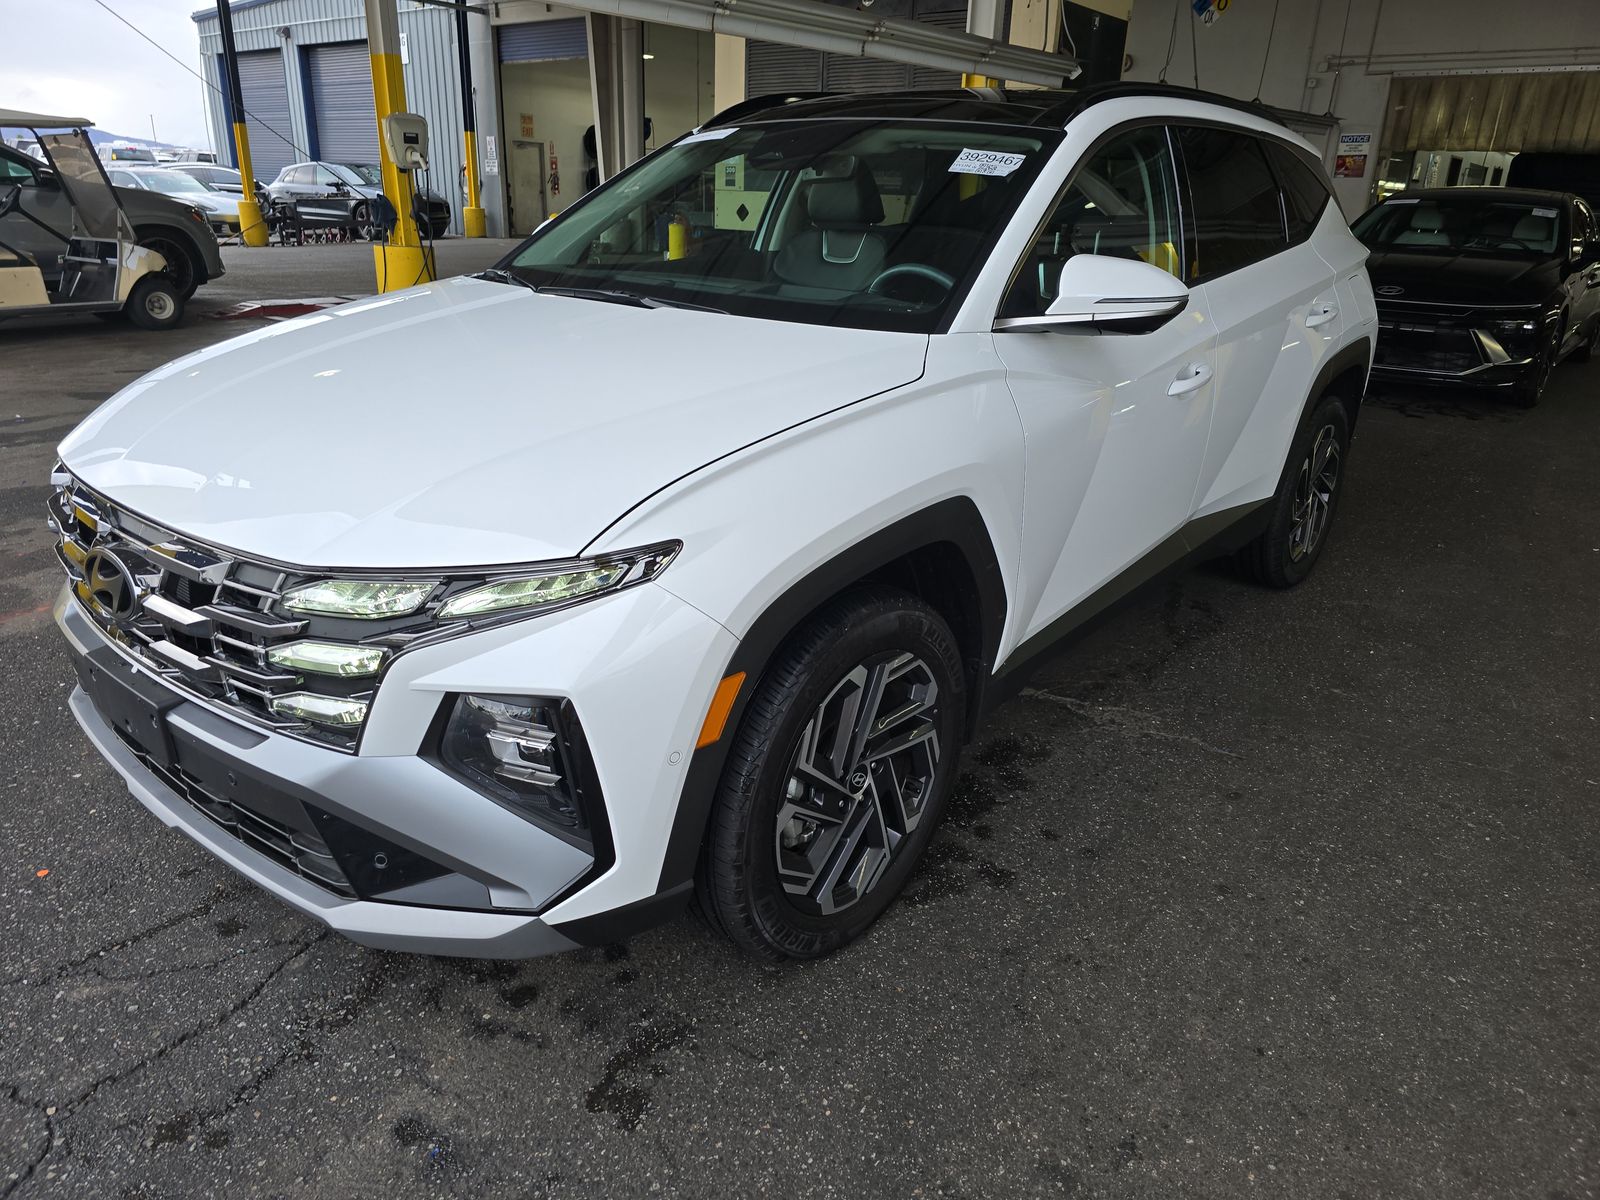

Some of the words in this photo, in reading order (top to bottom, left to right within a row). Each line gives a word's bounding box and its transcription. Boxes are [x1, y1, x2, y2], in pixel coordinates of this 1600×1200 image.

[1204, 9, 1216, 24] OX
[1342, 135, 1370, 143] NOTICE
[960, 152, 1024, 166] 3929467
